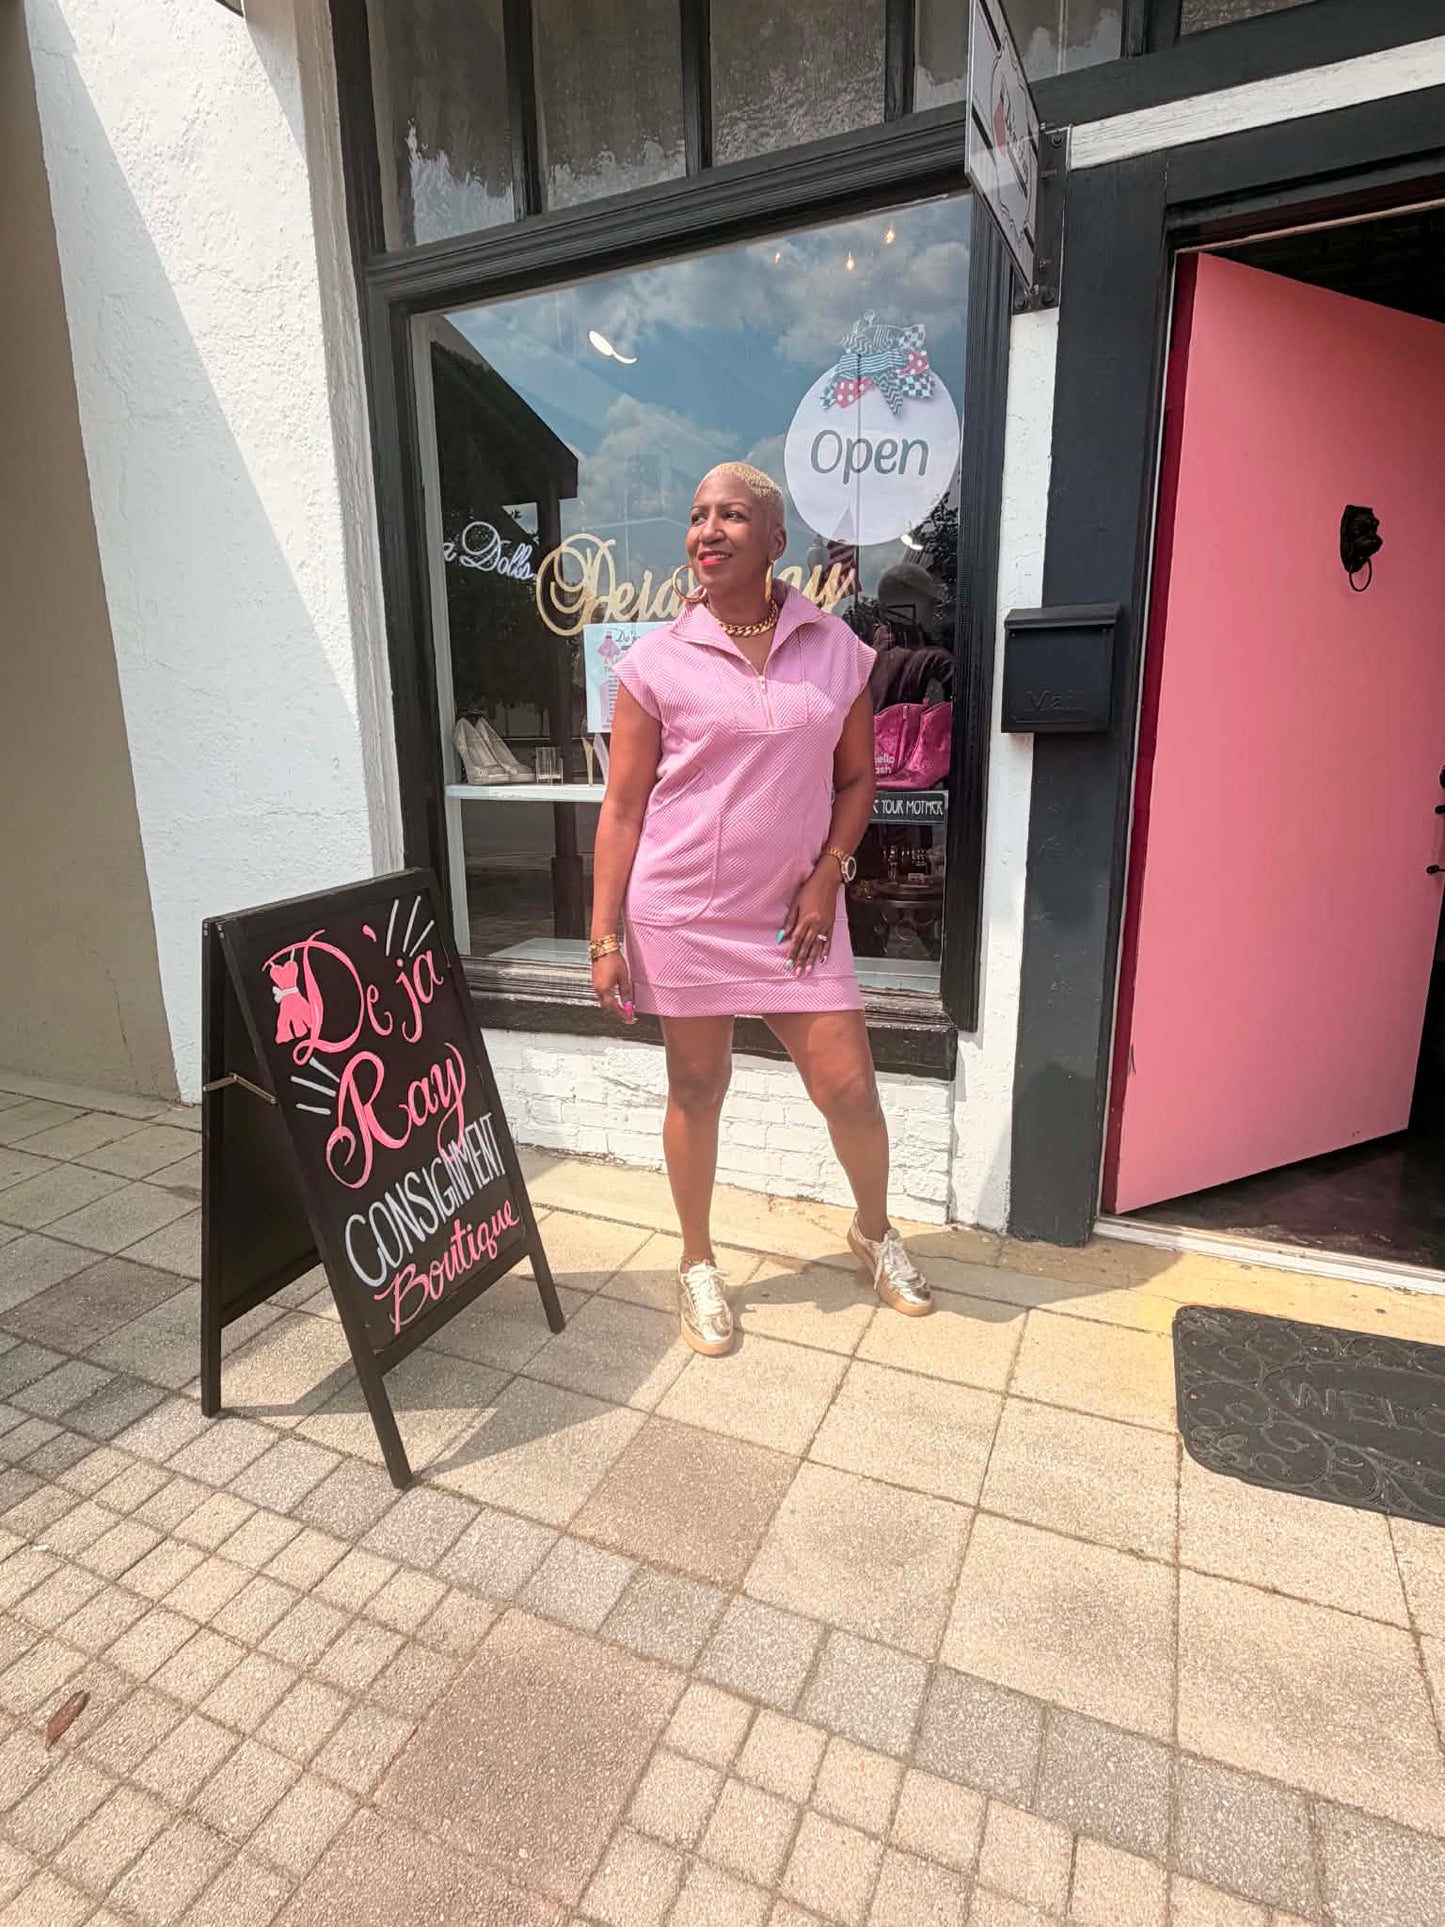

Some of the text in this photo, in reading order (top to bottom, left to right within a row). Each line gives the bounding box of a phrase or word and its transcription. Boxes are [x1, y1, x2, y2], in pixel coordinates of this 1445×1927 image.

[810, 429, 929, 486] Open
[459, 521, 536, 580] Dolls
[905, 799, 944, 816] MOTHER
[326, 1042, 467, 1189] Ray
[345, 1112, 506, 1288] CONSIGNMENT
[373, 1200, 520, 1336] Boutique
